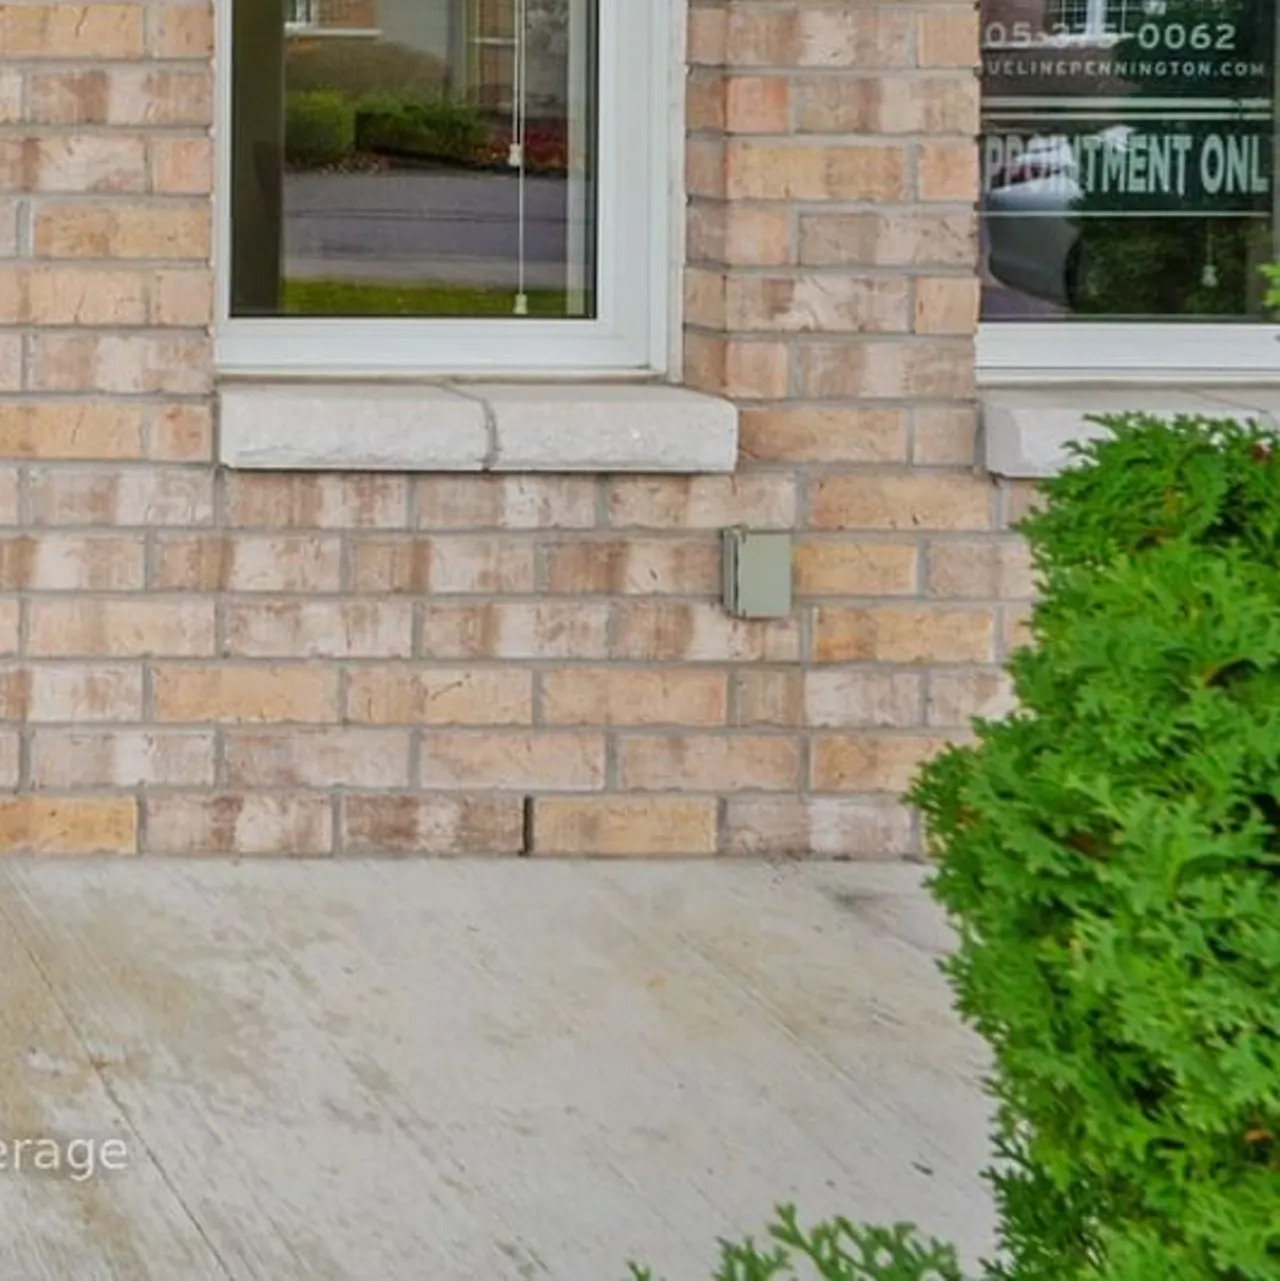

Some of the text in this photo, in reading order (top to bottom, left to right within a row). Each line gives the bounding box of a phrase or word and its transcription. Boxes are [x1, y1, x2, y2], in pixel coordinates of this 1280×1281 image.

[984, 61, 1266, 77] UELINEPENNINGTON.COM
[984, 134, 1270, 197] PPOINTMENT ONL
